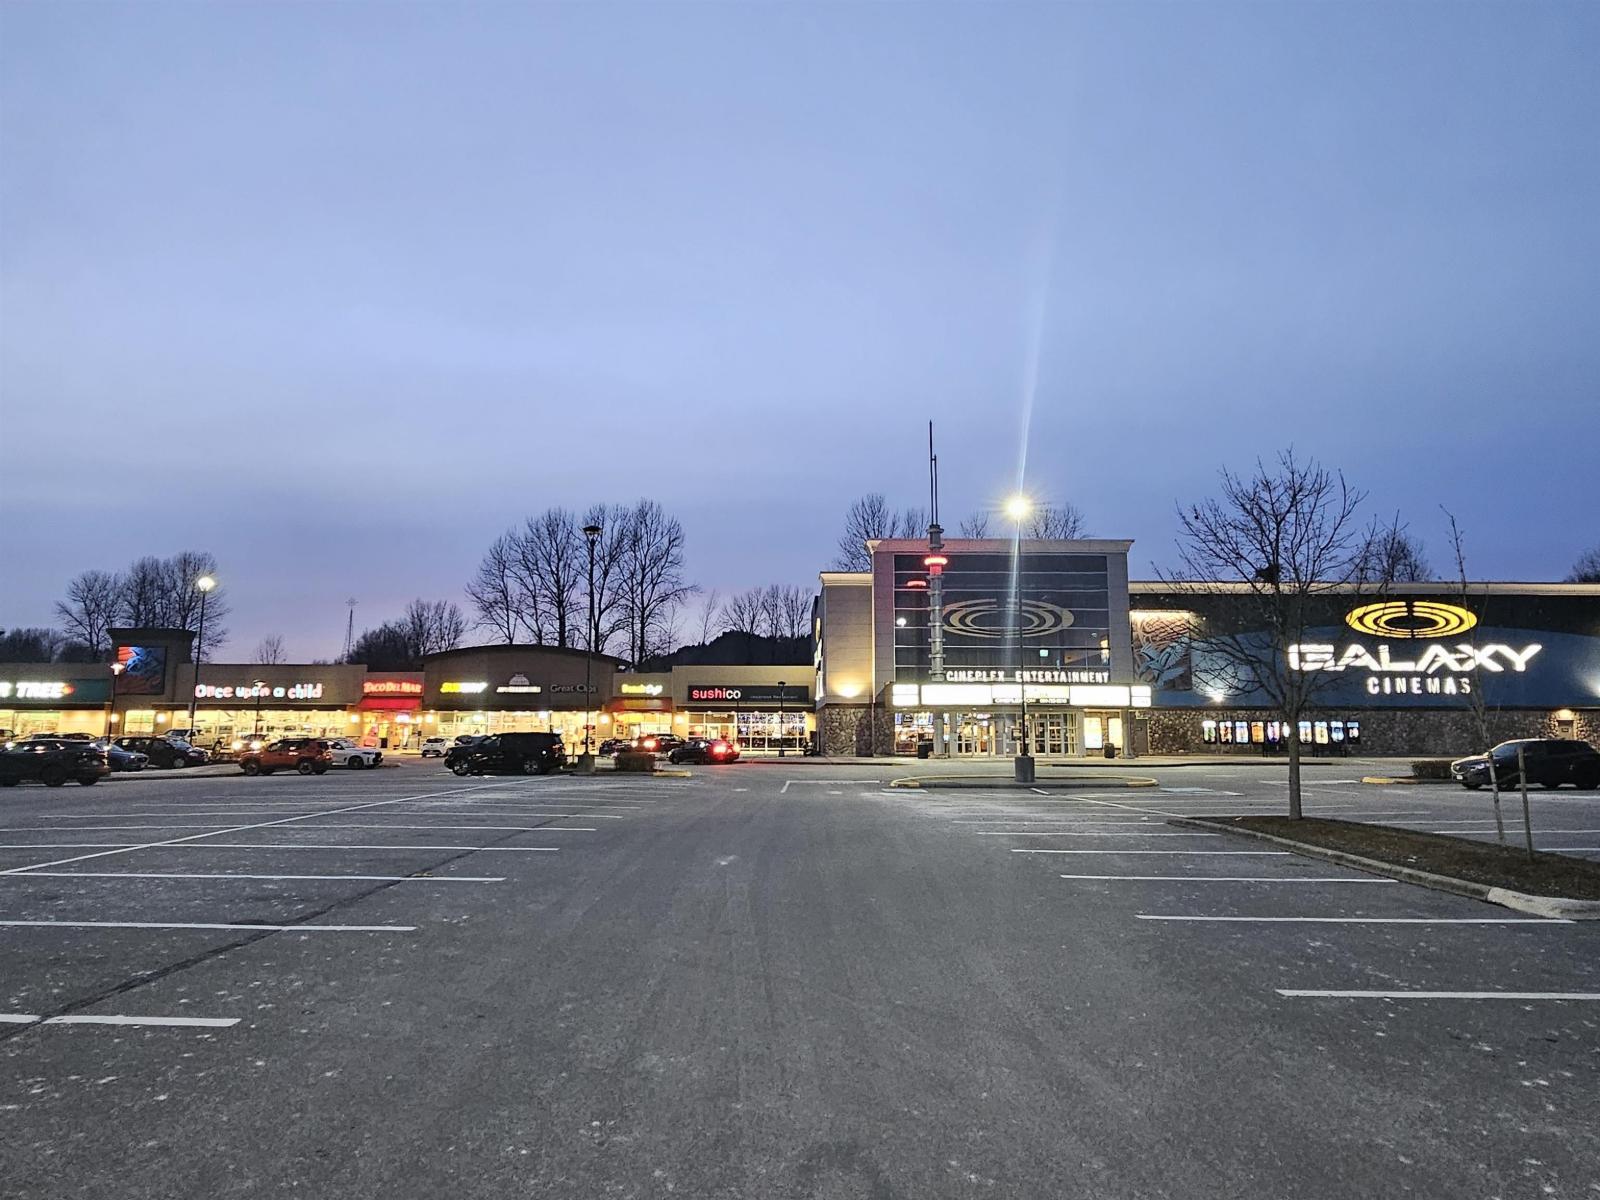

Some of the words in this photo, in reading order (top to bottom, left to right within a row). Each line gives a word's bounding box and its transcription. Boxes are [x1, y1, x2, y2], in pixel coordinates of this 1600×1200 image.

[1287, 643, 1542, 673] GALAXY
[945, 671, 1005, 682] CINEPLEX
[1015, 671, 1109, 683] ENTERTAINMENT
[16, 681, 65, 699] TREE
[194, 684, 234, 698] Once
[235, 686, 271, 699] upon
[272, 686, 286, 698] a
[287, 683, 323, 699] child
[363, 682, 385, 693] TACO
[401, 682, 422, 693] MAR
[550, 684, 574, 693] Great
[1366, 676, 1472, 695] CINEMAS
[692, 688, 741, 699] sushico
